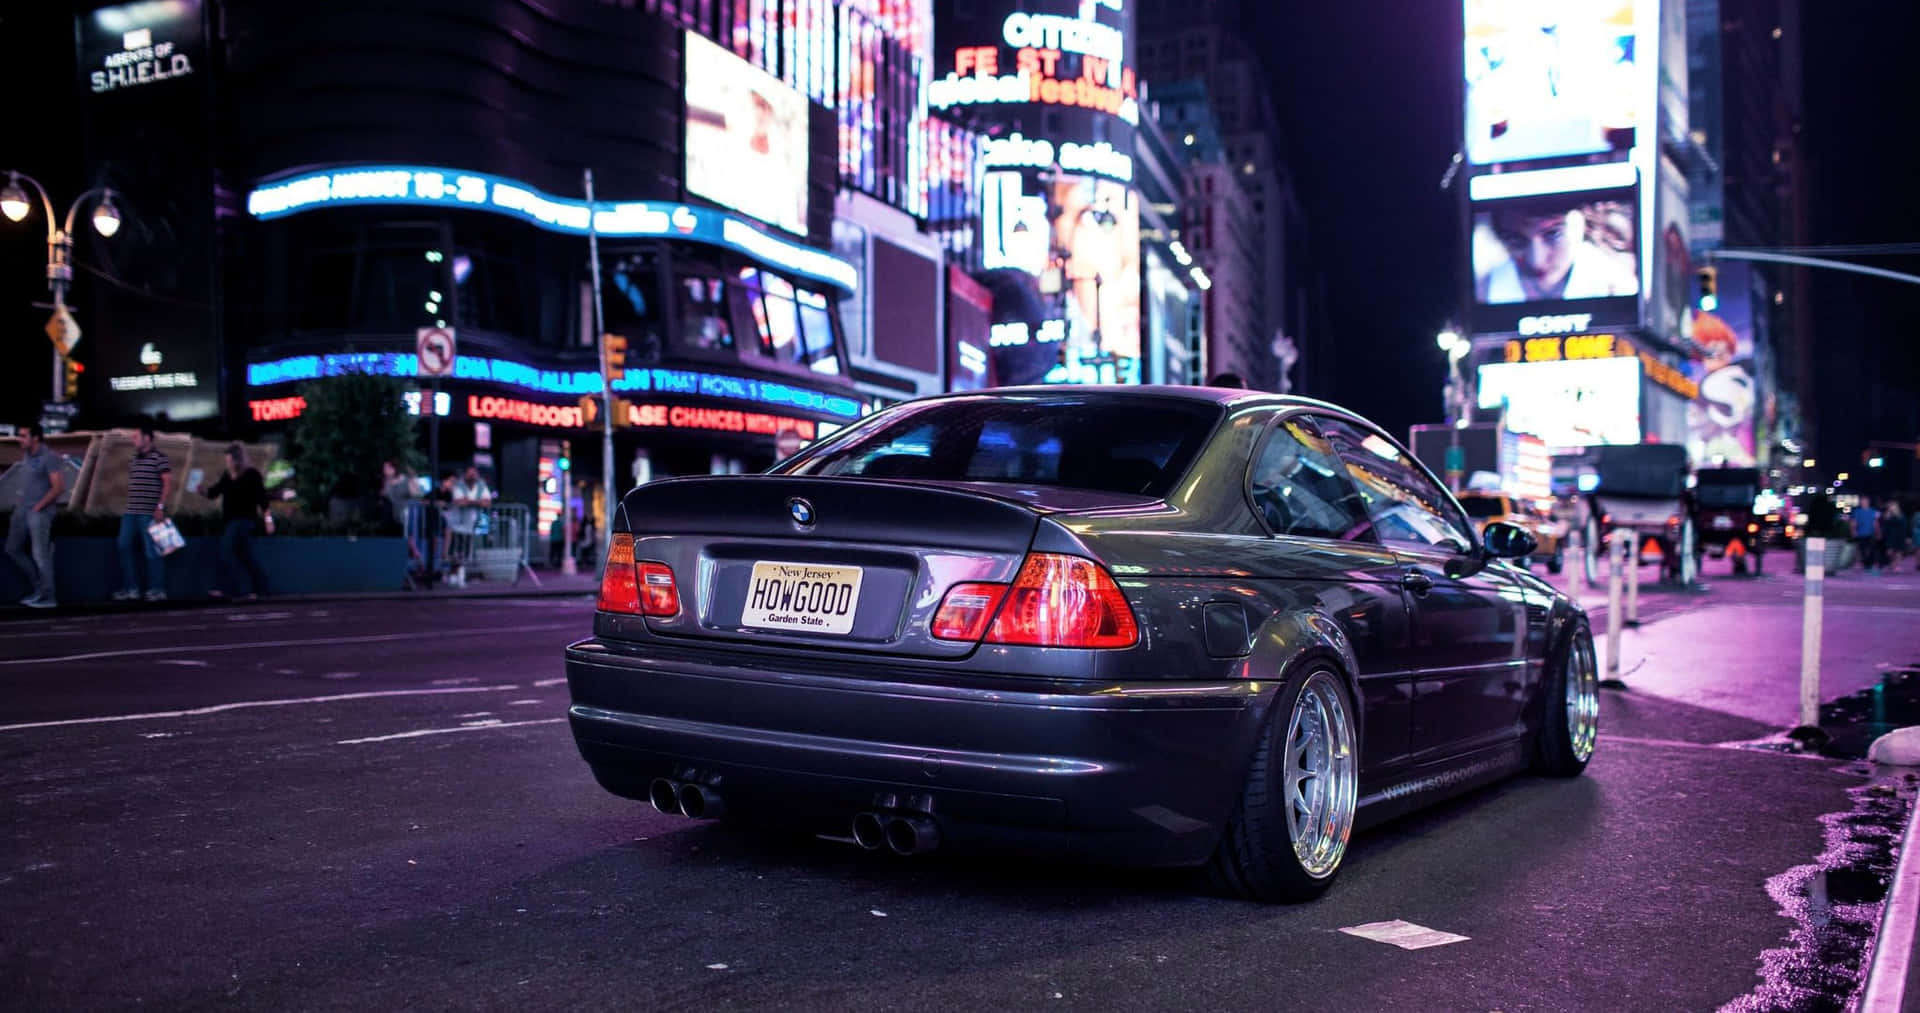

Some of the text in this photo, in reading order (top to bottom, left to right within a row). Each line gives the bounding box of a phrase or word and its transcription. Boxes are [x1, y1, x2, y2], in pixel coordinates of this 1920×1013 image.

[105, 41, 175, 68] AGENTS OF
[1519, 314, 1592, 335] SONY
[669, 406, 744, 432] CHANCES
[779, 566, 834, 582] New Jersey
[752, 578, 852, 615] HOWGOOD
[768, 614, 824, 626] Garden State
